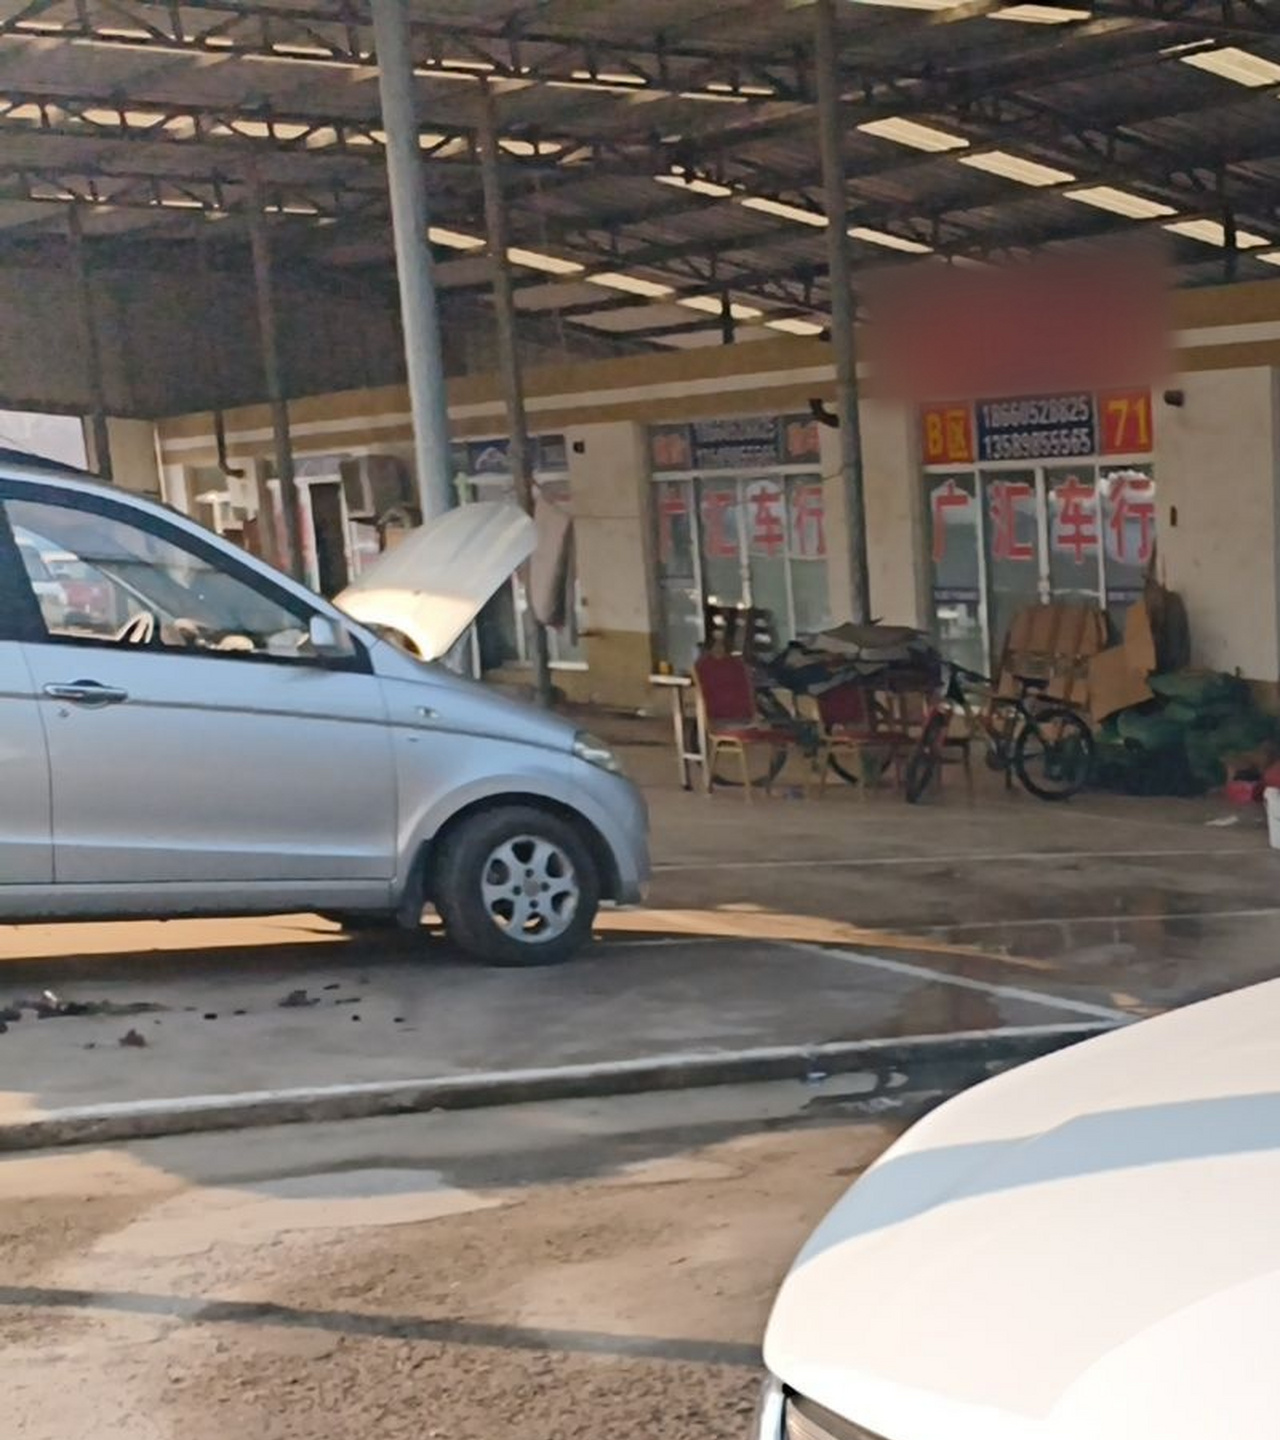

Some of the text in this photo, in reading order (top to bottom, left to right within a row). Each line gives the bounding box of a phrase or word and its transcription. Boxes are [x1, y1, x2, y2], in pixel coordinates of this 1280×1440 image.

[1108, 397, 1149, 447] 71
[931, 472, 1155, 563] 广汇车行
